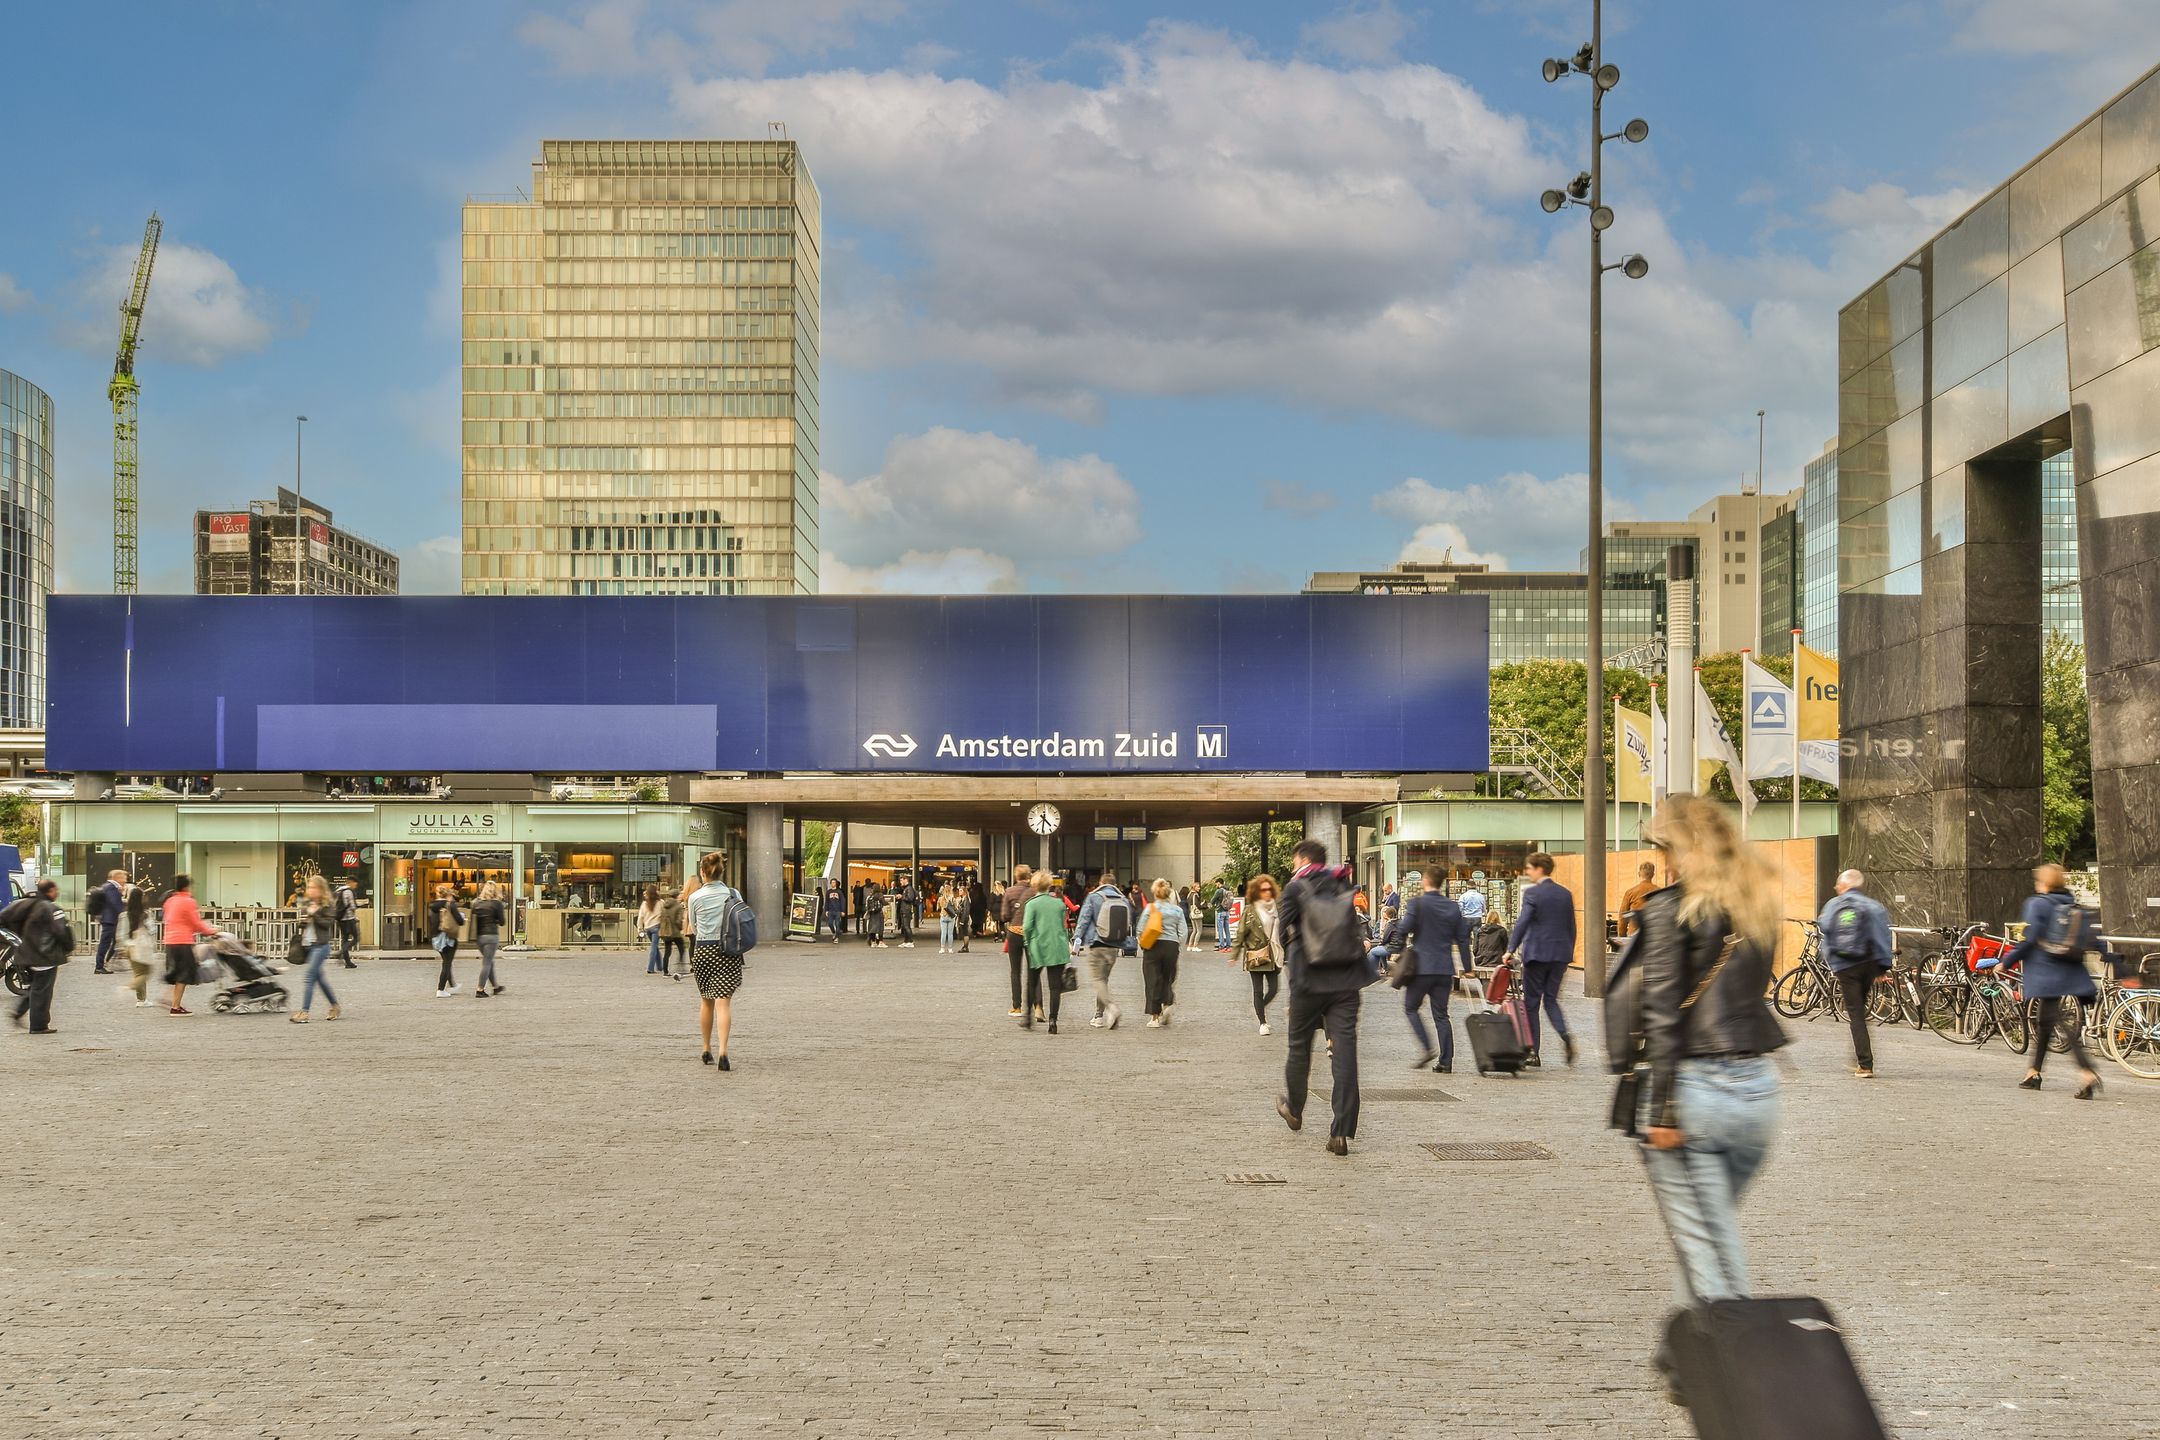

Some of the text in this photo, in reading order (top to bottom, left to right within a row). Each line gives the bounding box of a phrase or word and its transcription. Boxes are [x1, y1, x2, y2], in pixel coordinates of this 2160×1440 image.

[213, 516, 231, 524] PRO
[222, 524, 246, 533] VAST
[935, 732, 1222, 758] Amsterdam Zuid M
[410, 814, 494, 827] JULIA'S
[343, 854, 358, 867] illy
